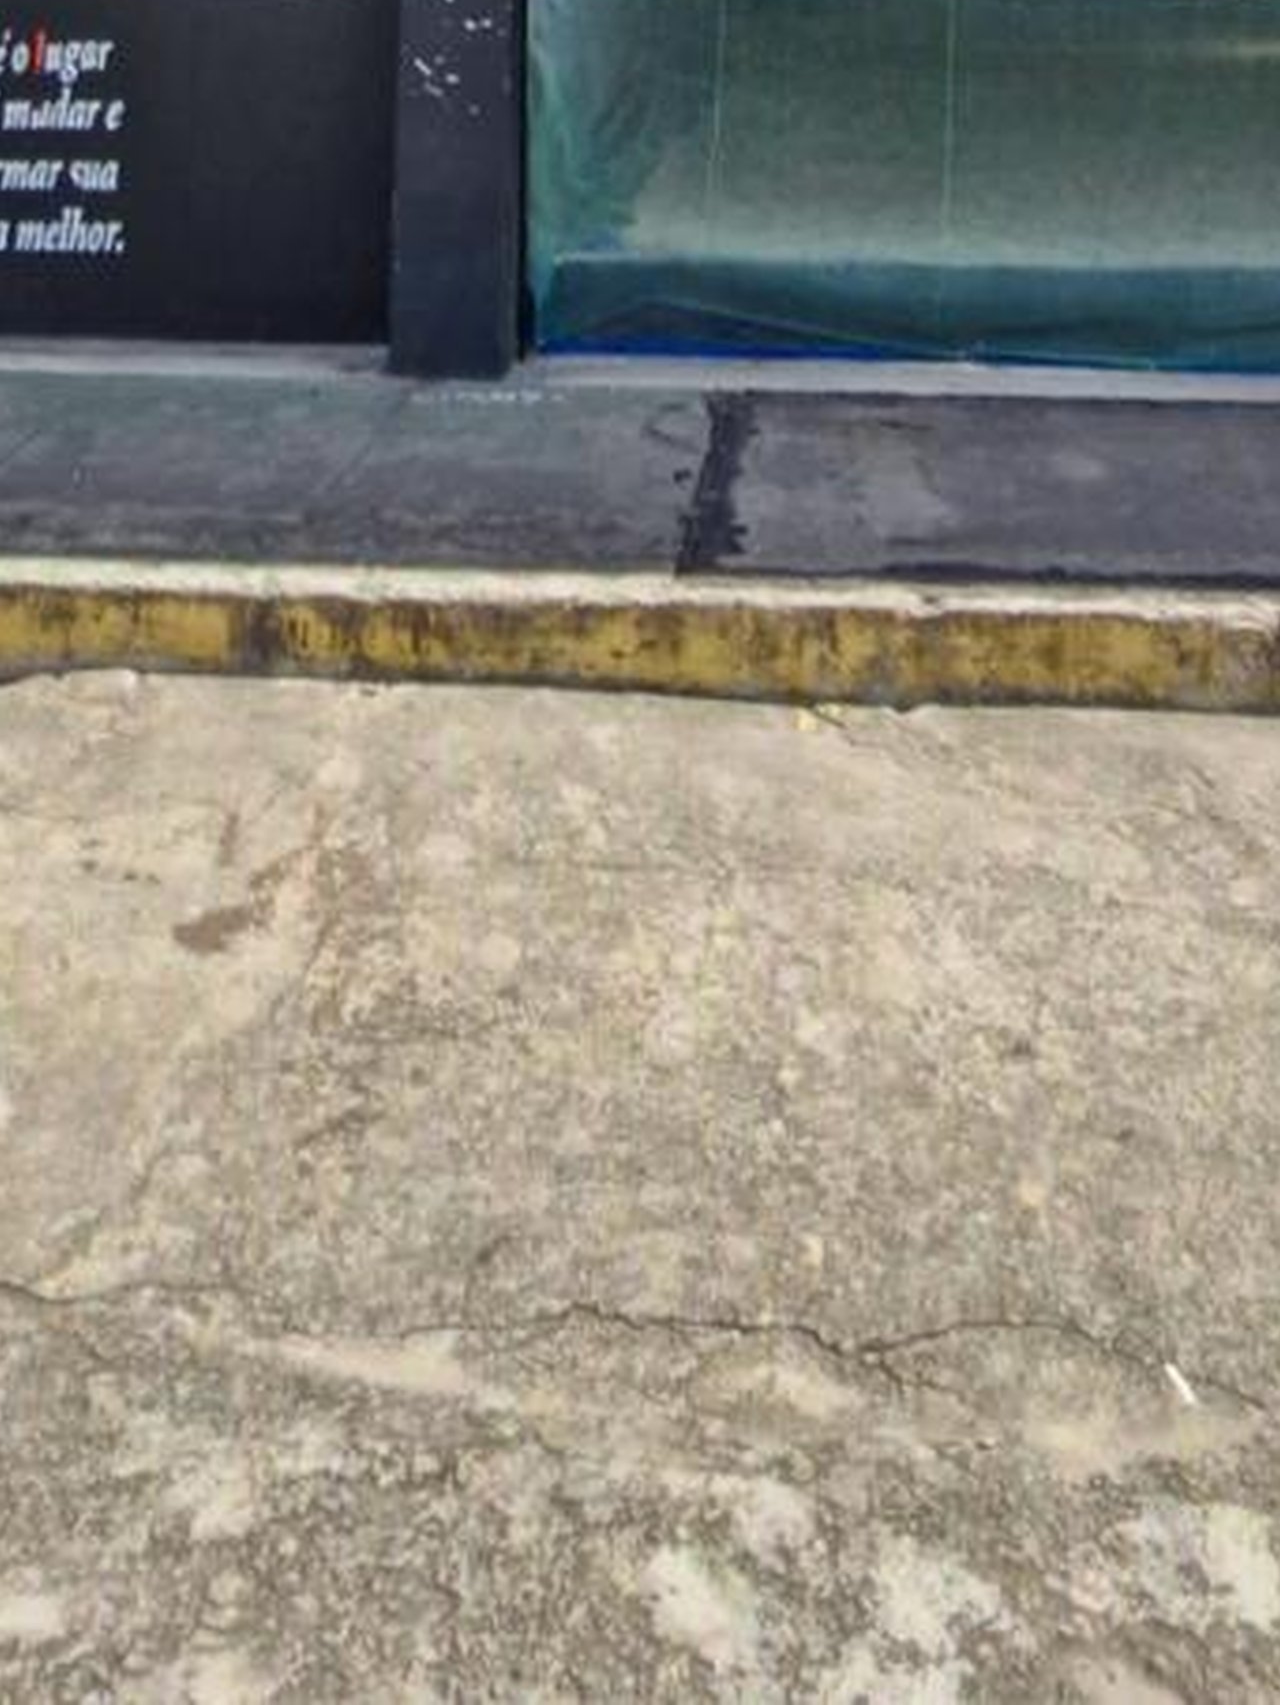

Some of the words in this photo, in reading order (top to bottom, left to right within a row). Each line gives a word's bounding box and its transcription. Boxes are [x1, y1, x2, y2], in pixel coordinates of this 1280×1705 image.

[12, 42, 31, 74] o
[31, 28, 114, 84] lugar
[2, 88, 102, 131] mudar
[104, 99, 125, 131] e
[15, 206, 125, 252] melhor.
